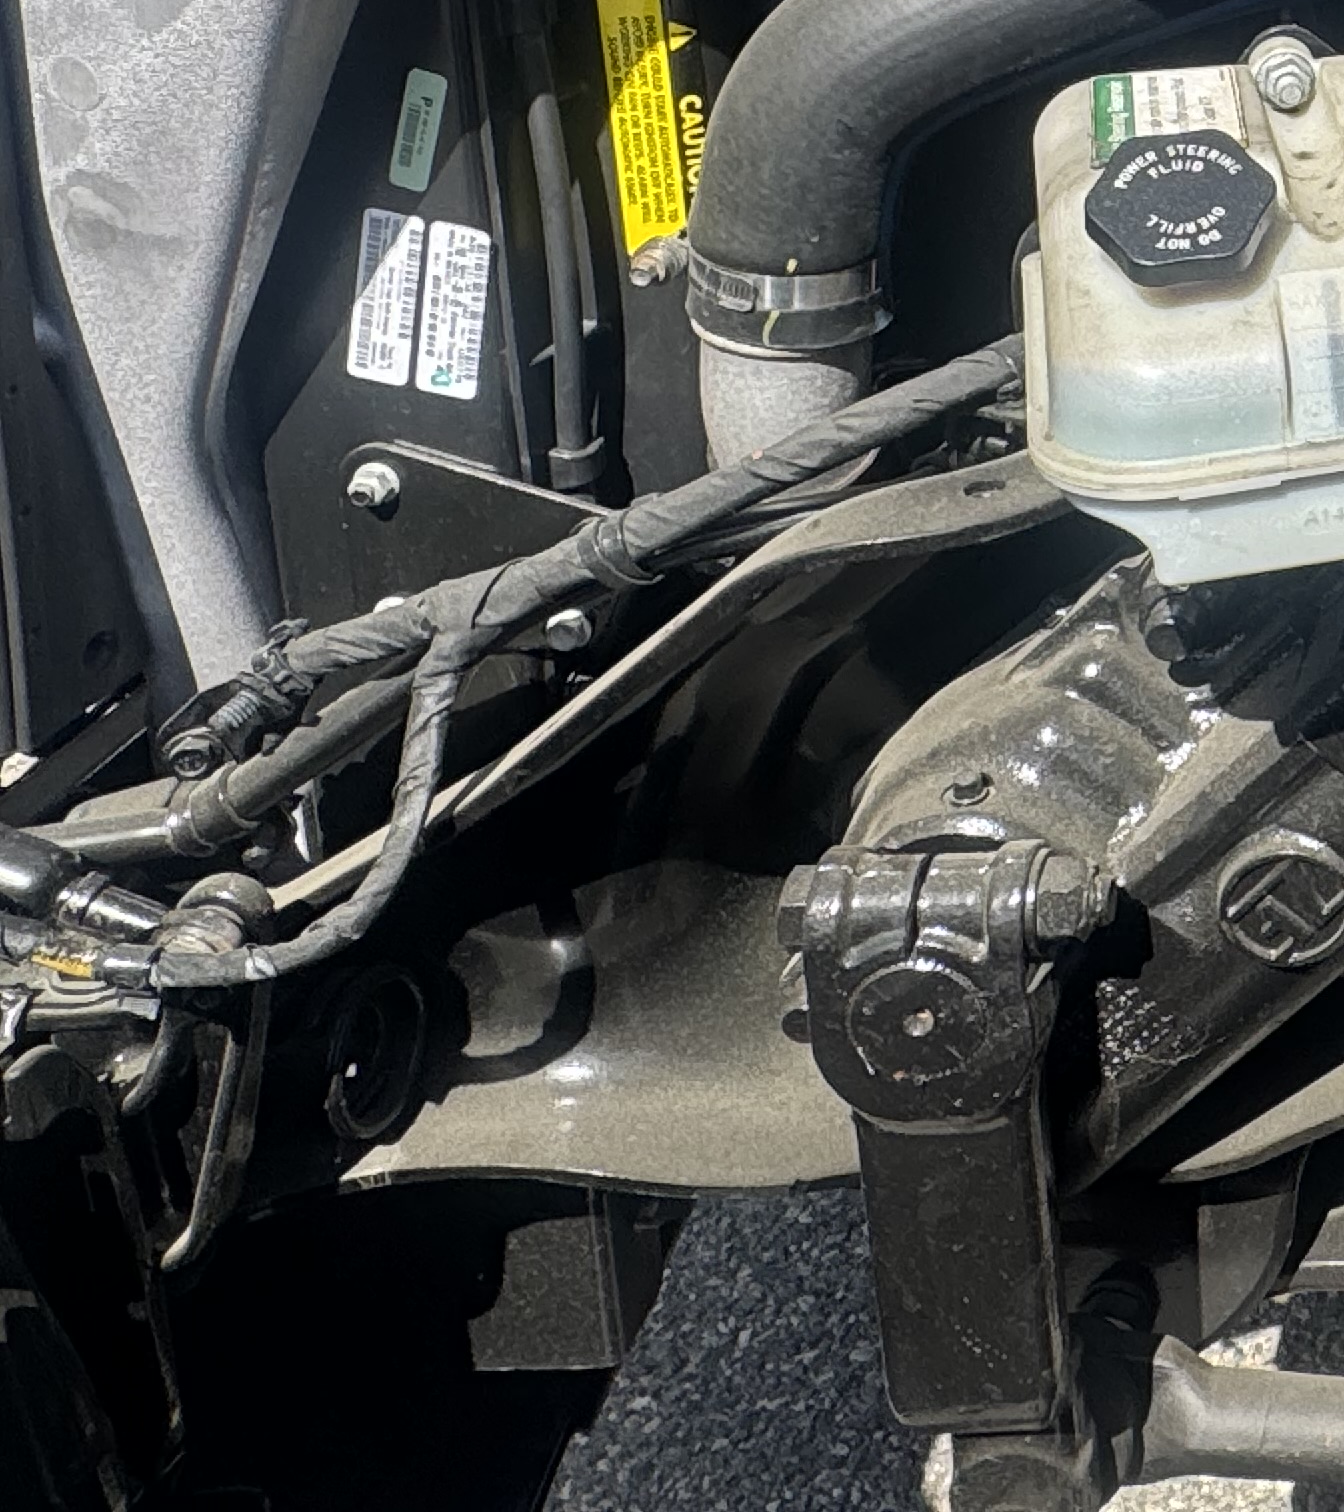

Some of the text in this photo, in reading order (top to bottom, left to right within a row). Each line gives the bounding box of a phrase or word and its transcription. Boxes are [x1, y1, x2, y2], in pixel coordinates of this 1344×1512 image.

[1113, 143, 1244, 190] POWER STEERING
[1146, 158, 1205, 180] FLUID
[1145, 205, 1227, 236] OVERFILL
[1154, 228, 1224, 251] DO NOT
